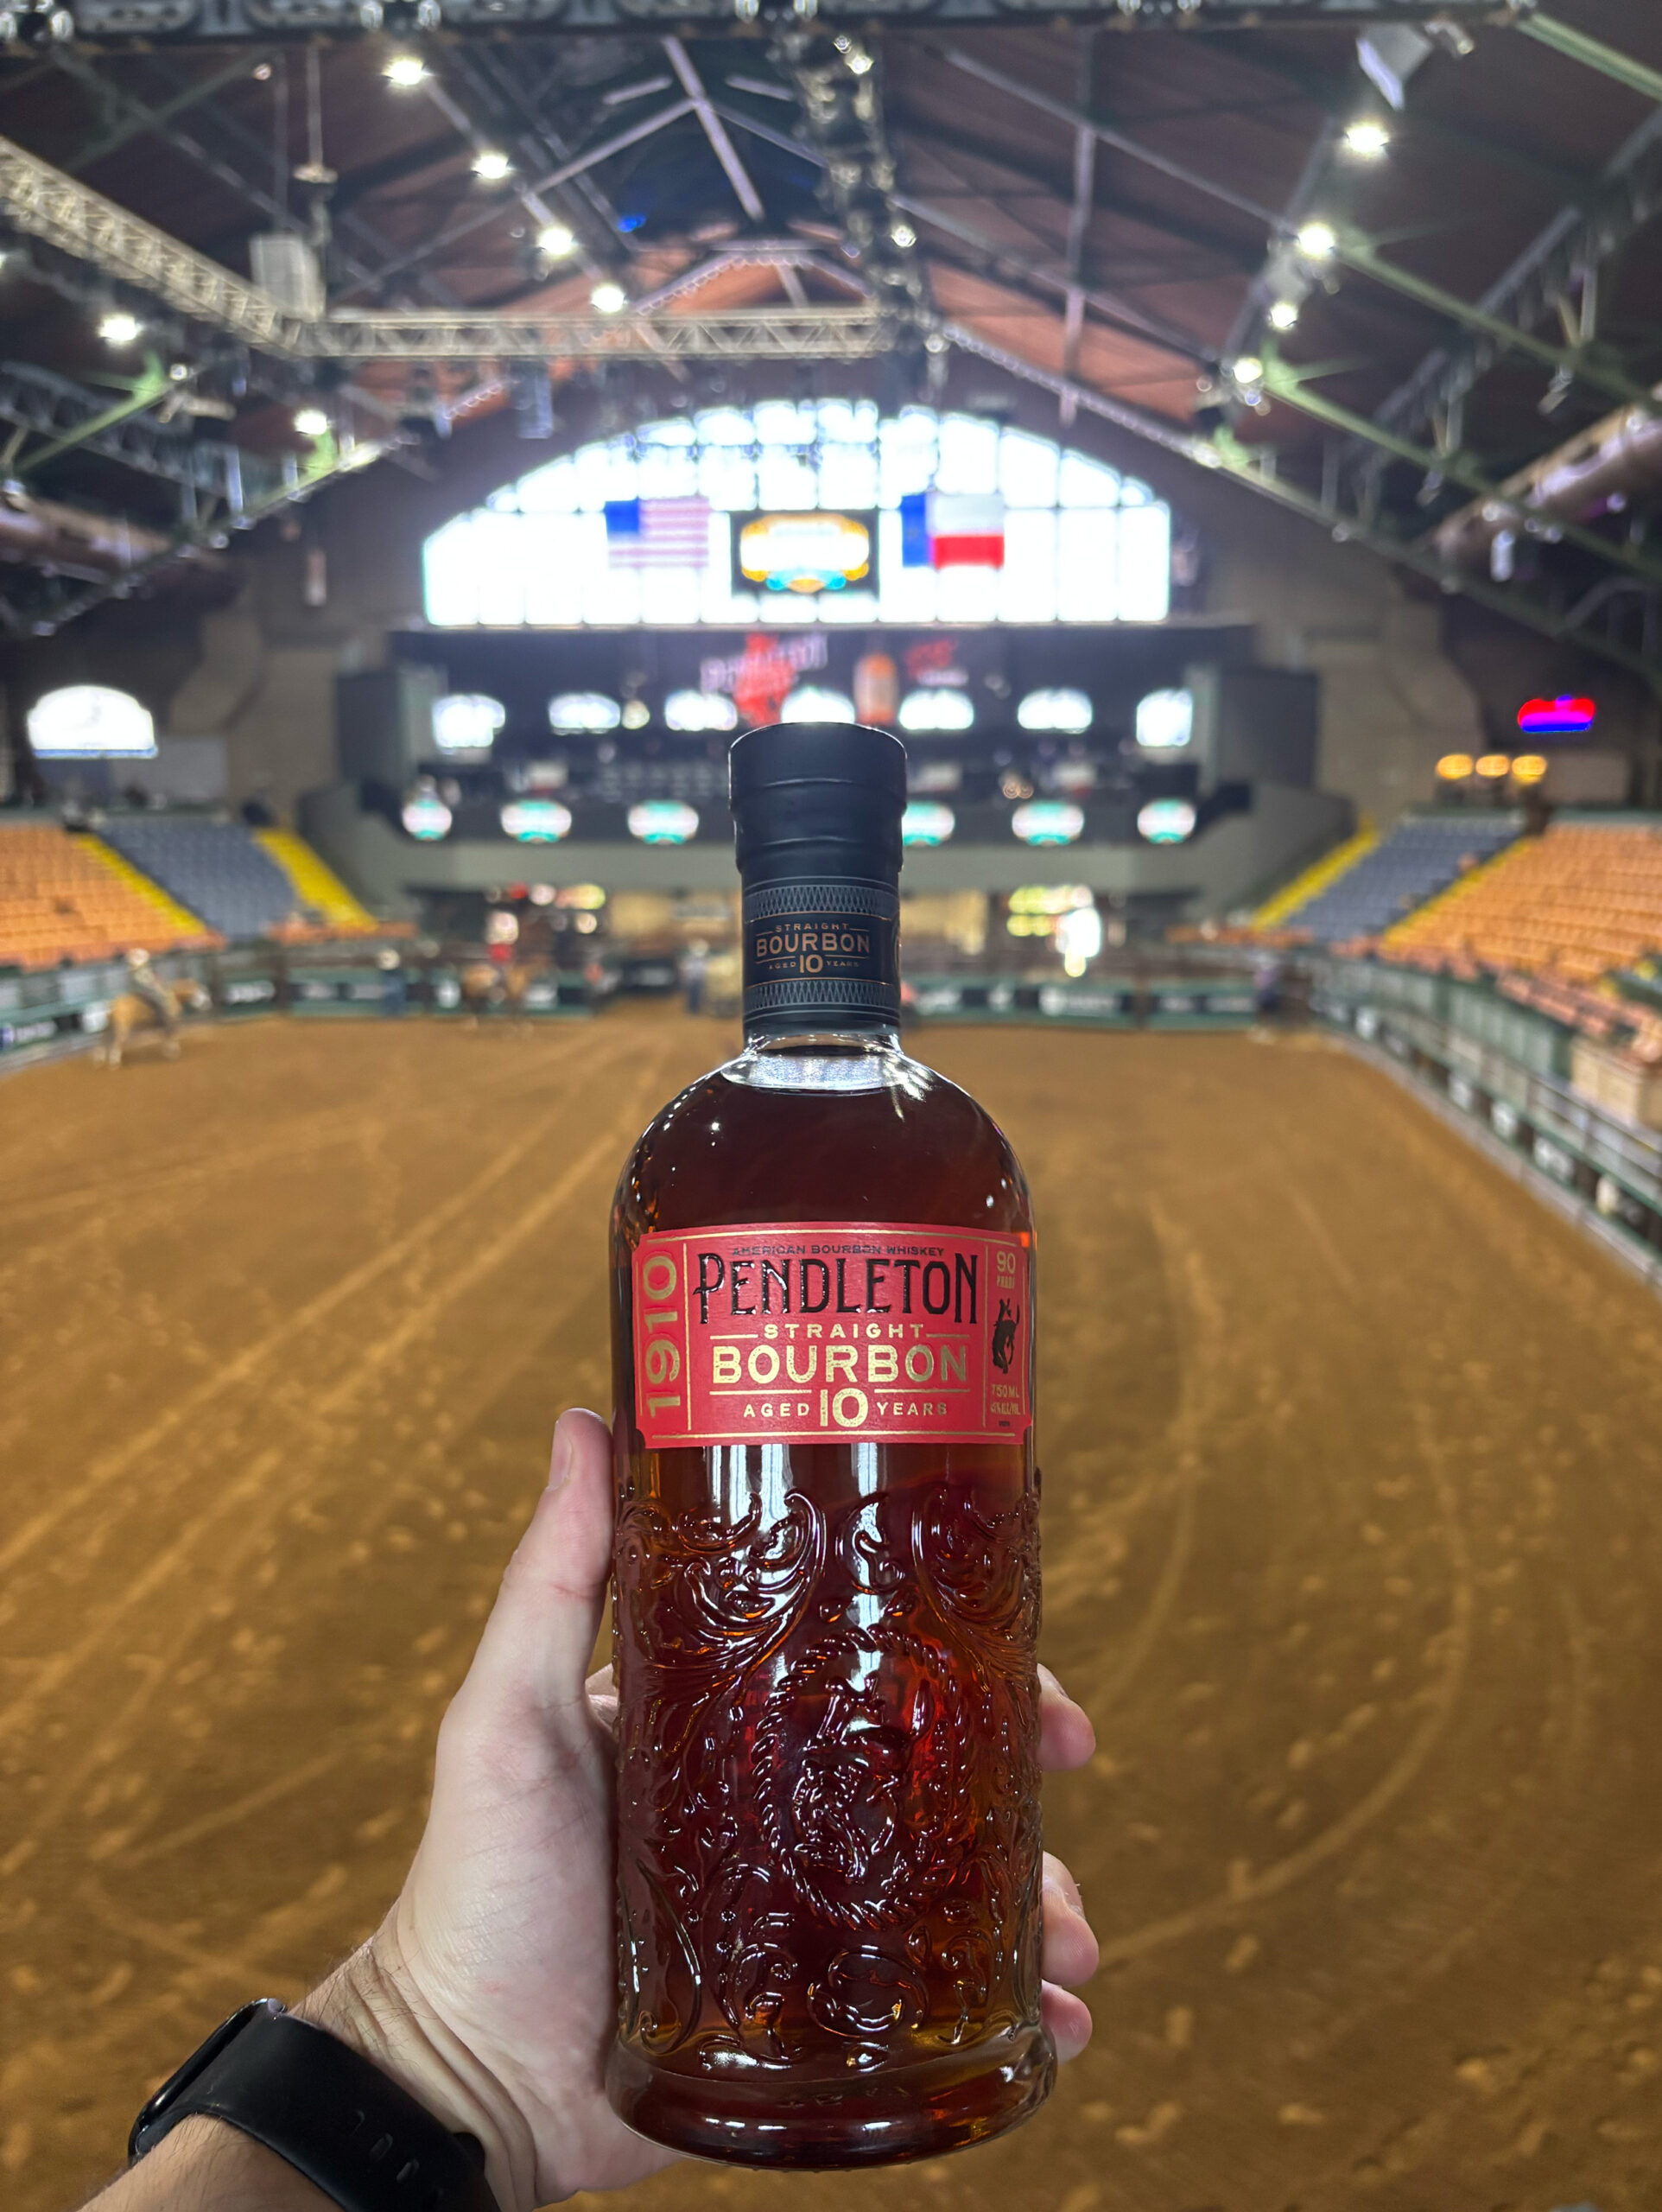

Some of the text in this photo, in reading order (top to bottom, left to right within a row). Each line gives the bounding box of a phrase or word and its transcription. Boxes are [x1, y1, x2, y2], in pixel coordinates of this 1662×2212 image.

[775, 923, 850, 933] STRAIGHT
[756, 932, 870, 958] BOURBON
[799, 954, 823, 974] 10
[732, 1245, 946, 1256] AMERICAN BOURBON WHISKEY
[996, 1250, 1016, 1274] 90
[693, 1252, 978, 1325] PENDLETON
[642, 1255, 681, 1418] 1910
[764, 1323, 924, 1340] STRAIGHT
[713, 1344, 967, 1384] BOURBON
[743, 1387, 948, 1428] AGED 10 YEARS
